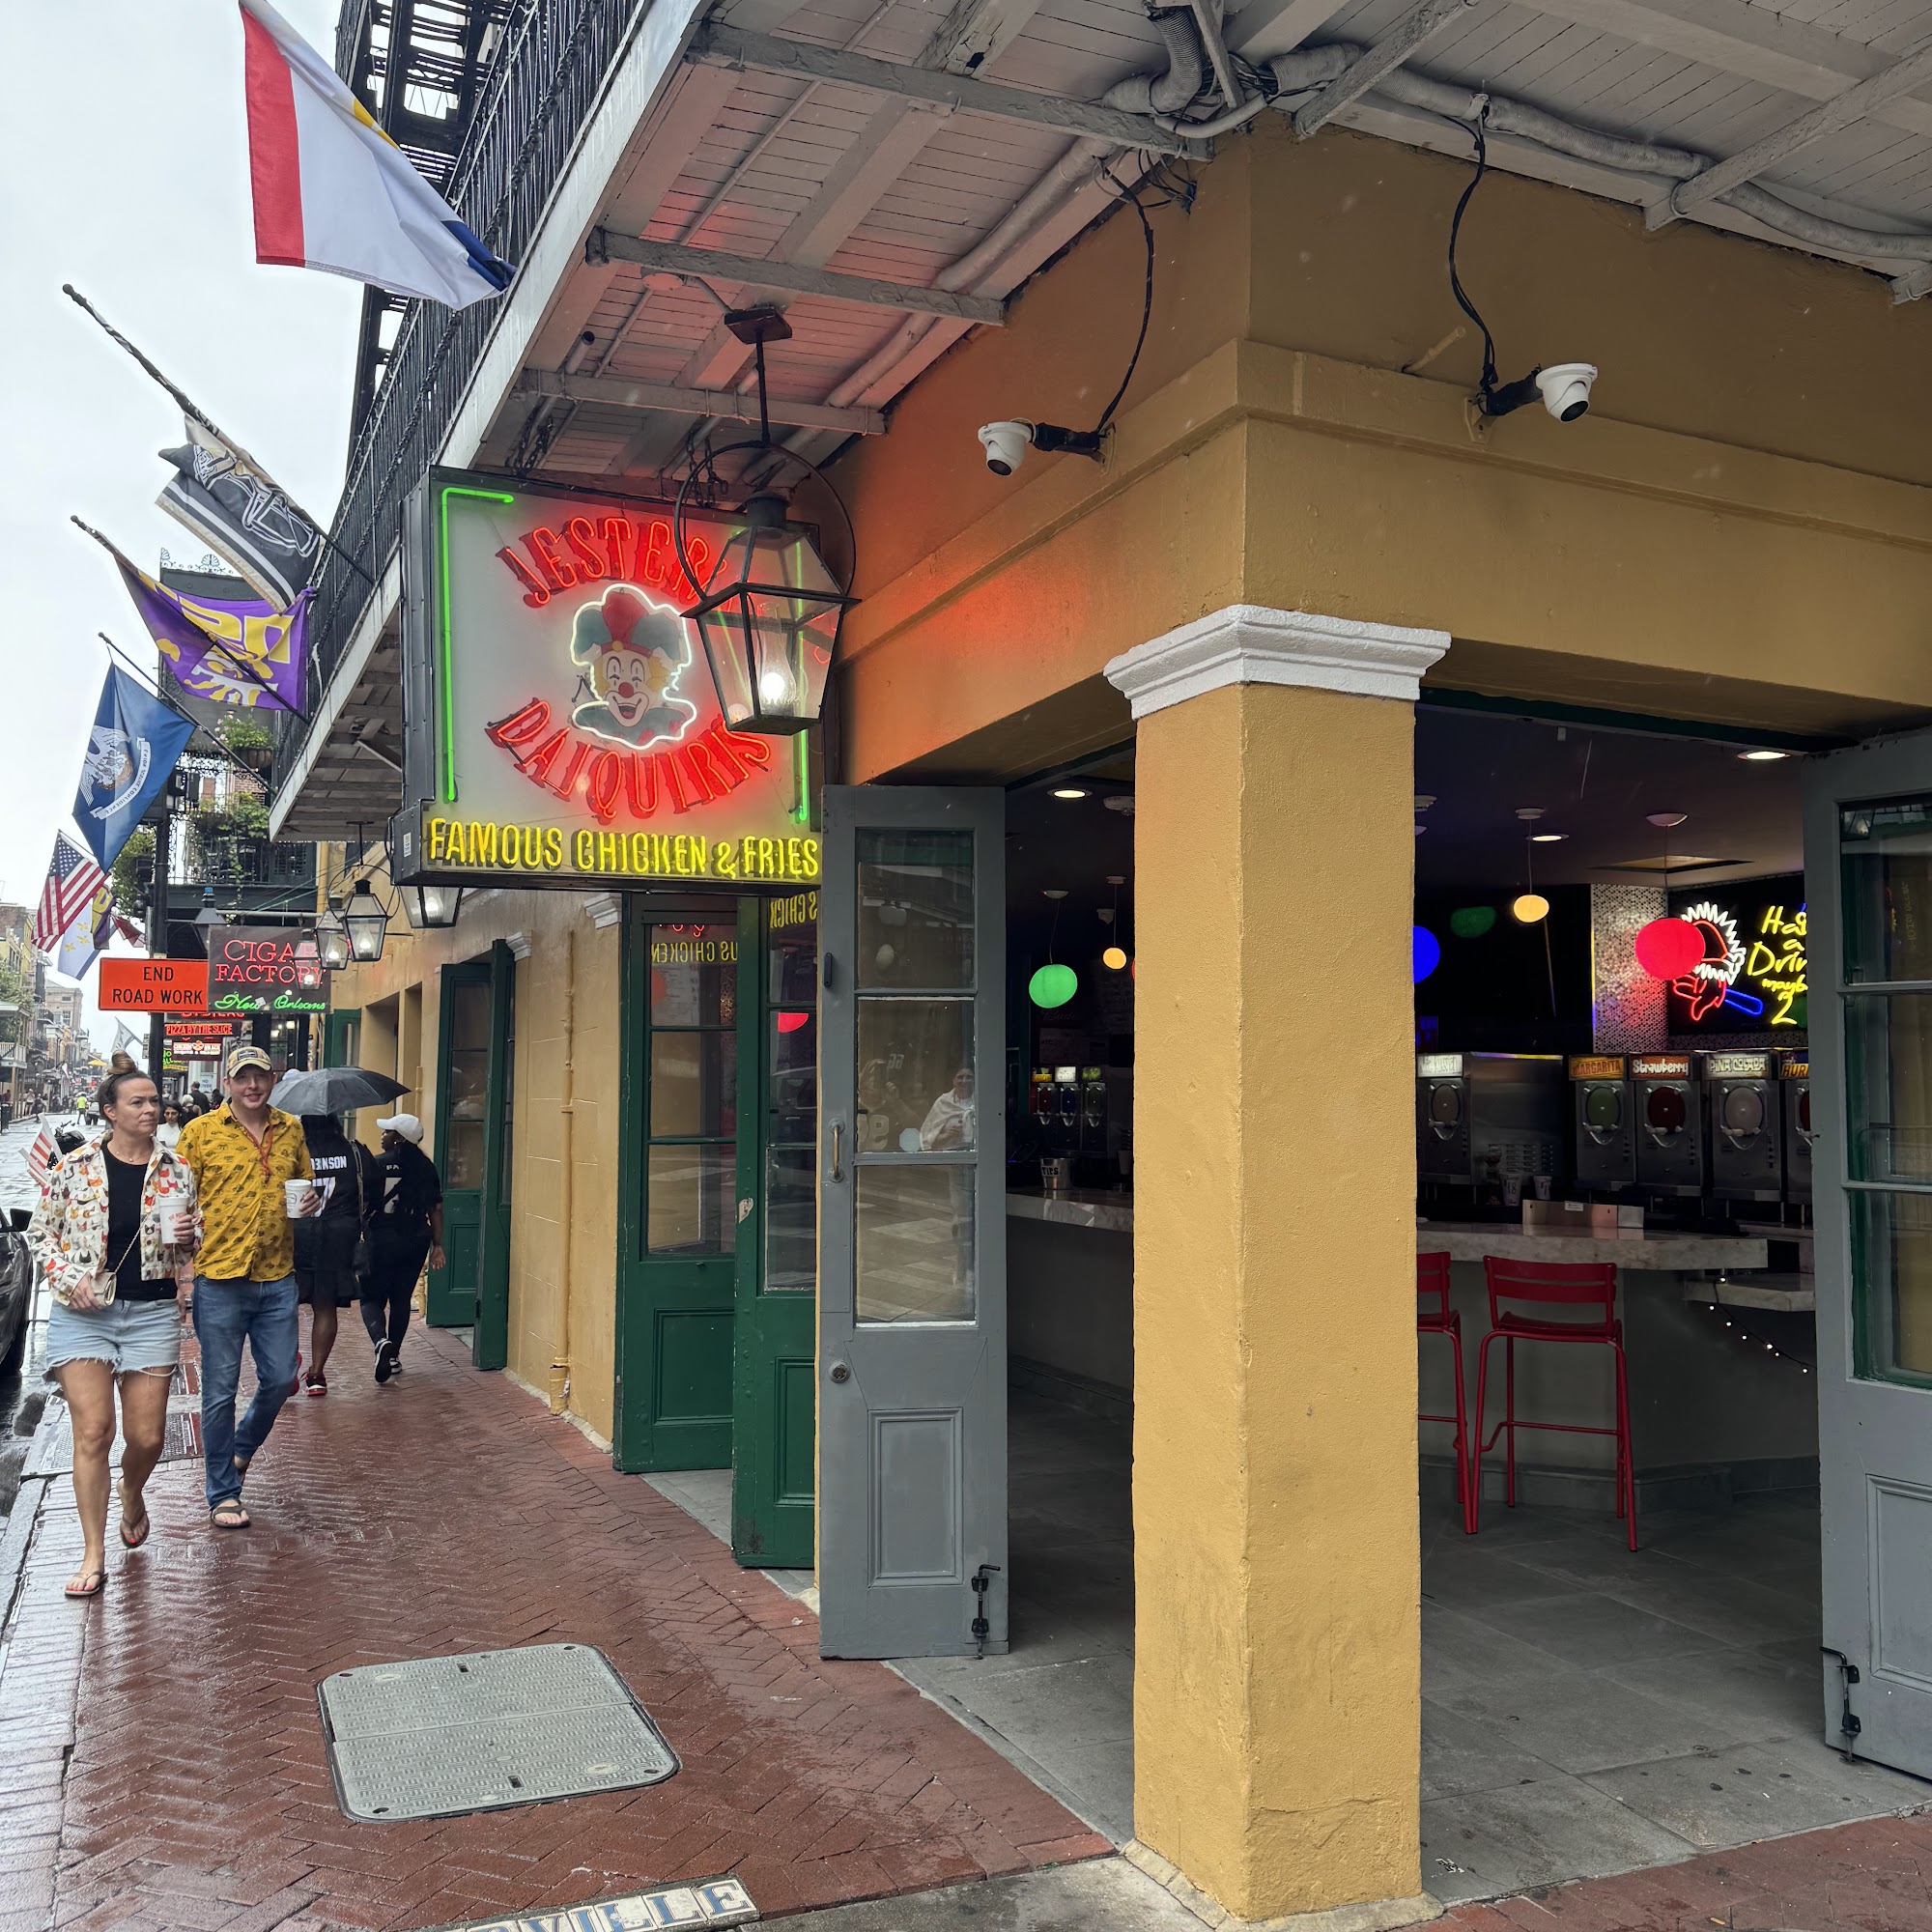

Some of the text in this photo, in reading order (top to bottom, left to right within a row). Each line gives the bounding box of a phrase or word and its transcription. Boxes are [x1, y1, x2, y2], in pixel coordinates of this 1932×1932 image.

[485, 697, 770, 825] DAIQUIRIS
[429, 817, 564, 868] FAMOUS
[576, 828, 707, 874] CHICKEN
[716, 841, 738, 880] &
[743, 835, 819, 879] FRIES
[224, 939, 320, 964] CIGAR
[143, 966, 174, 982] END
[214, 964, 324, 985] FACTORY
[112, 988, 203, 1005] ROAD WORK
[214, 993, 327, 1010] New Orleans
[1771, 991, 1798, 1025] 2
[166, 1024, 233, 1036] PIZZA BY THE SLICE
[1573, 1060, 1621, 1076] MARGARITA
[1632, 1059, 1690, 1076] Strawberry
[1733, 1057, 1767, 1072] COLADA
[1041, 1166, 1060, 1176] TIPS
